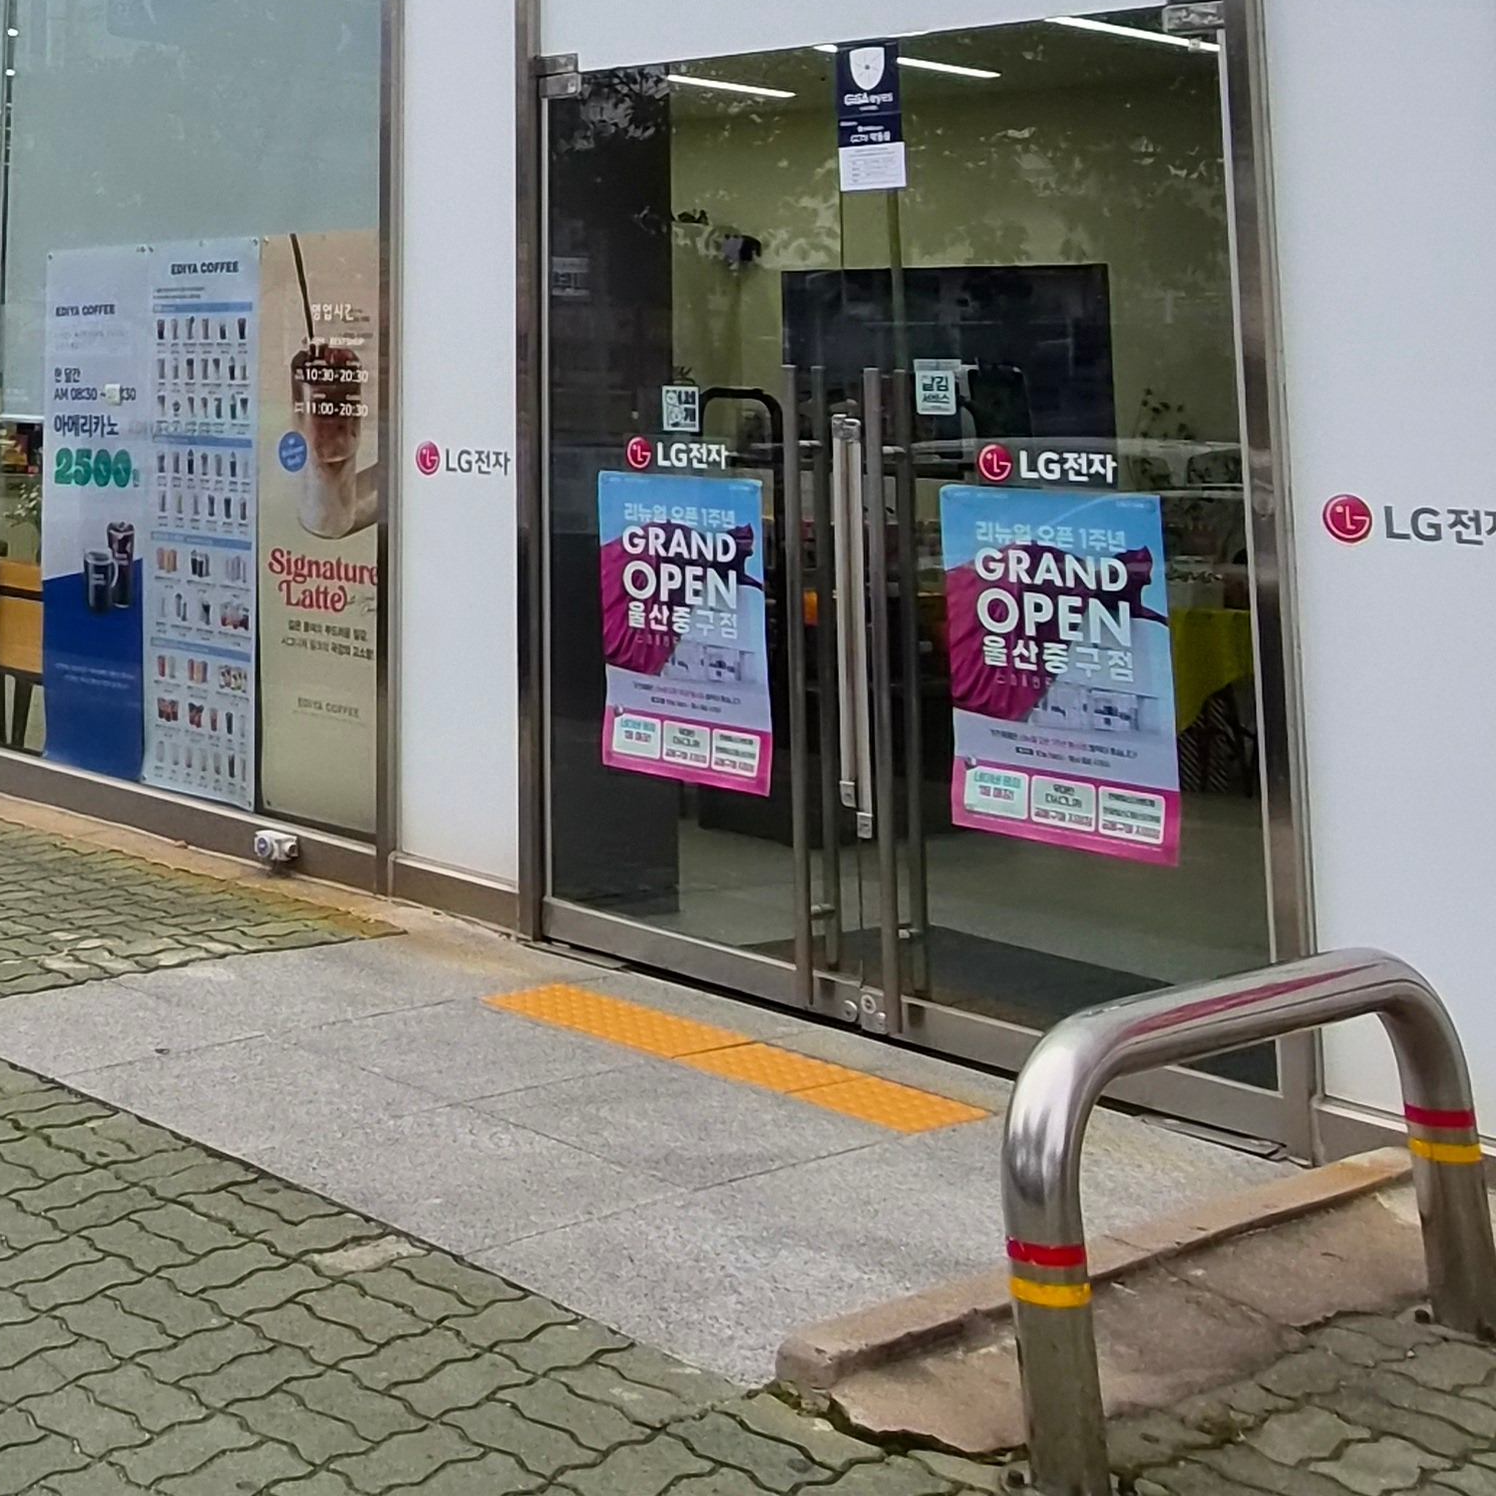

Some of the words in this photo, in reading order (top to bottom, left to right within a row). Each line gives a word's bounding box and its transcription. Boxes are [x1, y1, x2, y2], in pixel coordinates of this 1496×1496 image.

[171, 263, 198, 275] EDIYA
[201, 261, 239, 273] COFFEE
[55, 305, 80, 317] EDIYA
[82, 304, 115, 316] COFFEE
[311, 303, 355, 321] 영업시간
[54, 388, 69, 400] AM
[54, 414, 120, 437] 아메리카노
[445, 448, 511, 476] LG전자
[657, 441, 729, 470] LG전자
[1019, 450, 1117, 484] LG전자
[624, 502, 667, 524] 리뉴얼
[671, 506, 698, 526] 오픈
[701, 507, 735, 529] 1주년
[622, 525, 737, 563] GRAND
[975, 520, 1032, 546] 리뉴얼
[1037, 524, 1075, 549] 오픈
[1078, 528, 1127, 553] 1주년
[267, 547, 377, 586] Signature
[974, 547, 1128, 592] GRAND
[277, 579, 348, 613] Latte
[623, 560, 737, 609] OPEN
[628, 601, 738, 640] 울산중구점
[976, 587, 1132, 647] OPEN
[982, 635, 1134, 683] 울산중구점
